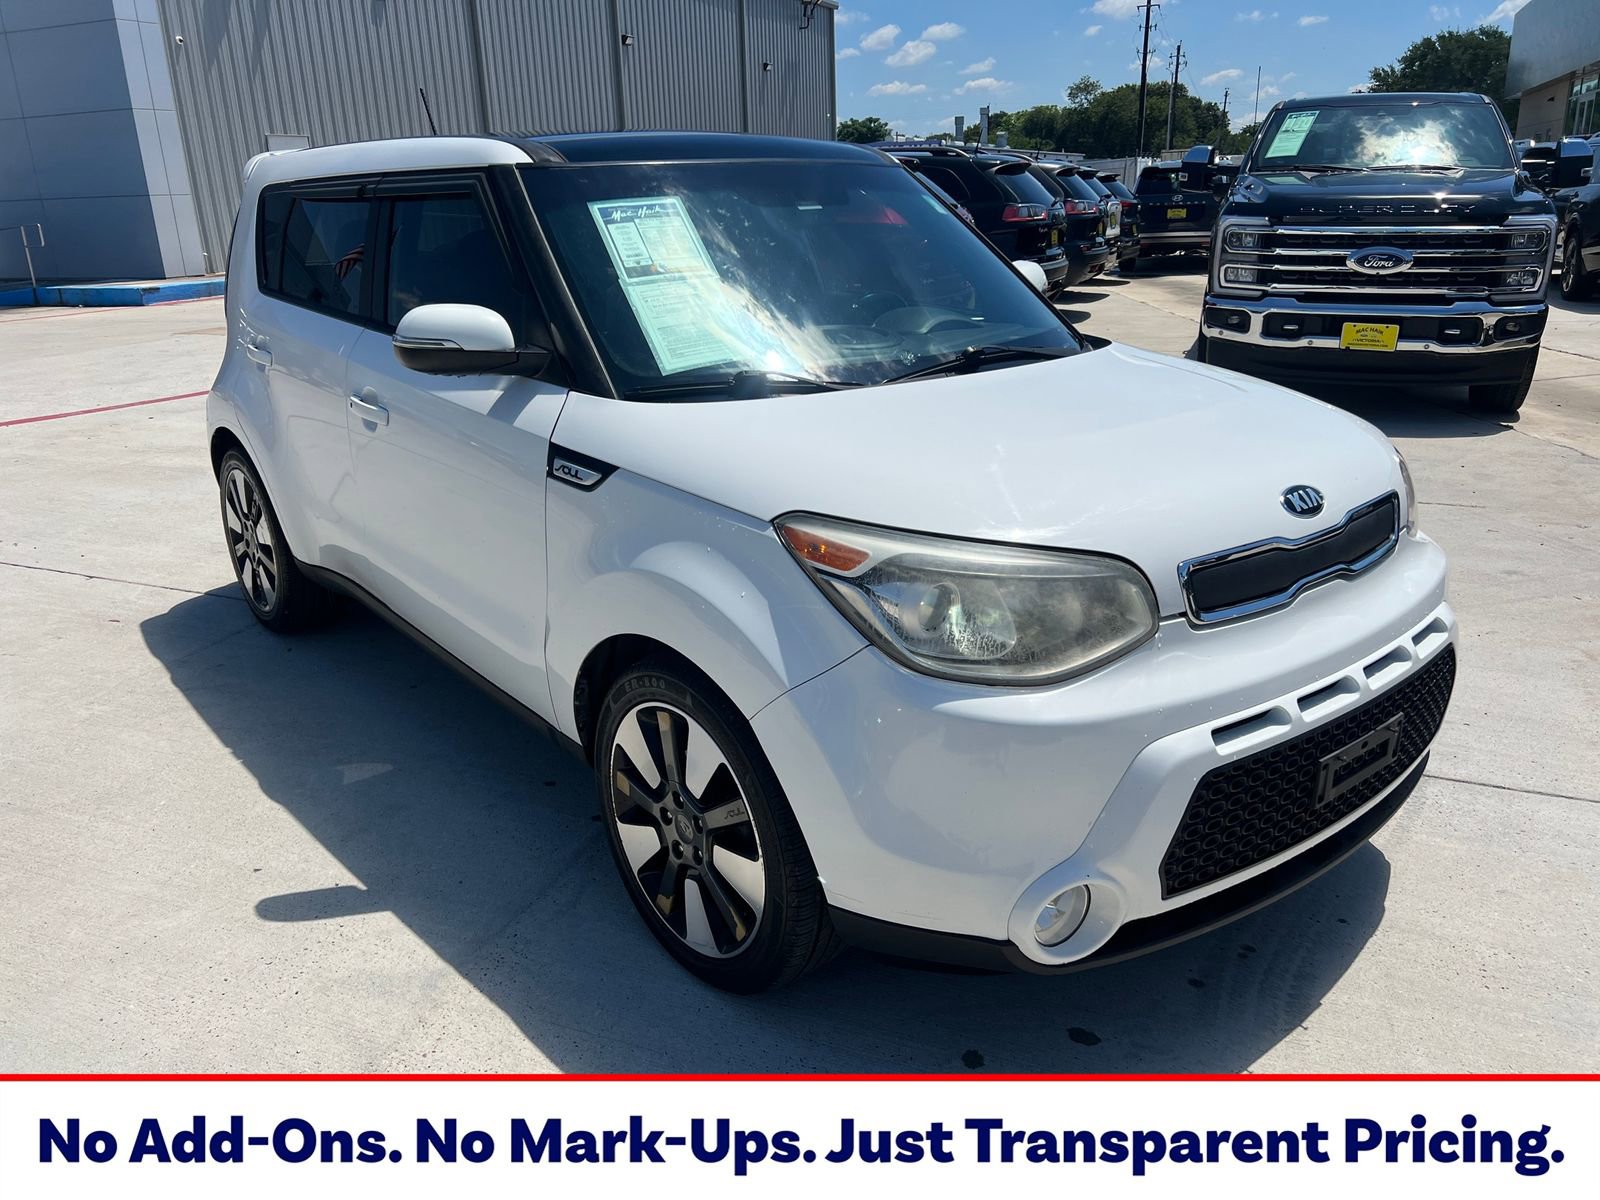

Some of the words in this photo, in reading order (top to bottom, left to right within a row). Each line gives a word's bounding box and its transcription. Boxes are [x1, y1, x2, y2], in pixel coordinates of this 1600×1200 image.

[1300, 205, 1393, 213] PER
[611, 210, 636, 221] Mac
[1364, 254, 1395, 267] Ford
[1286, 488, 1323, 511] KIA
